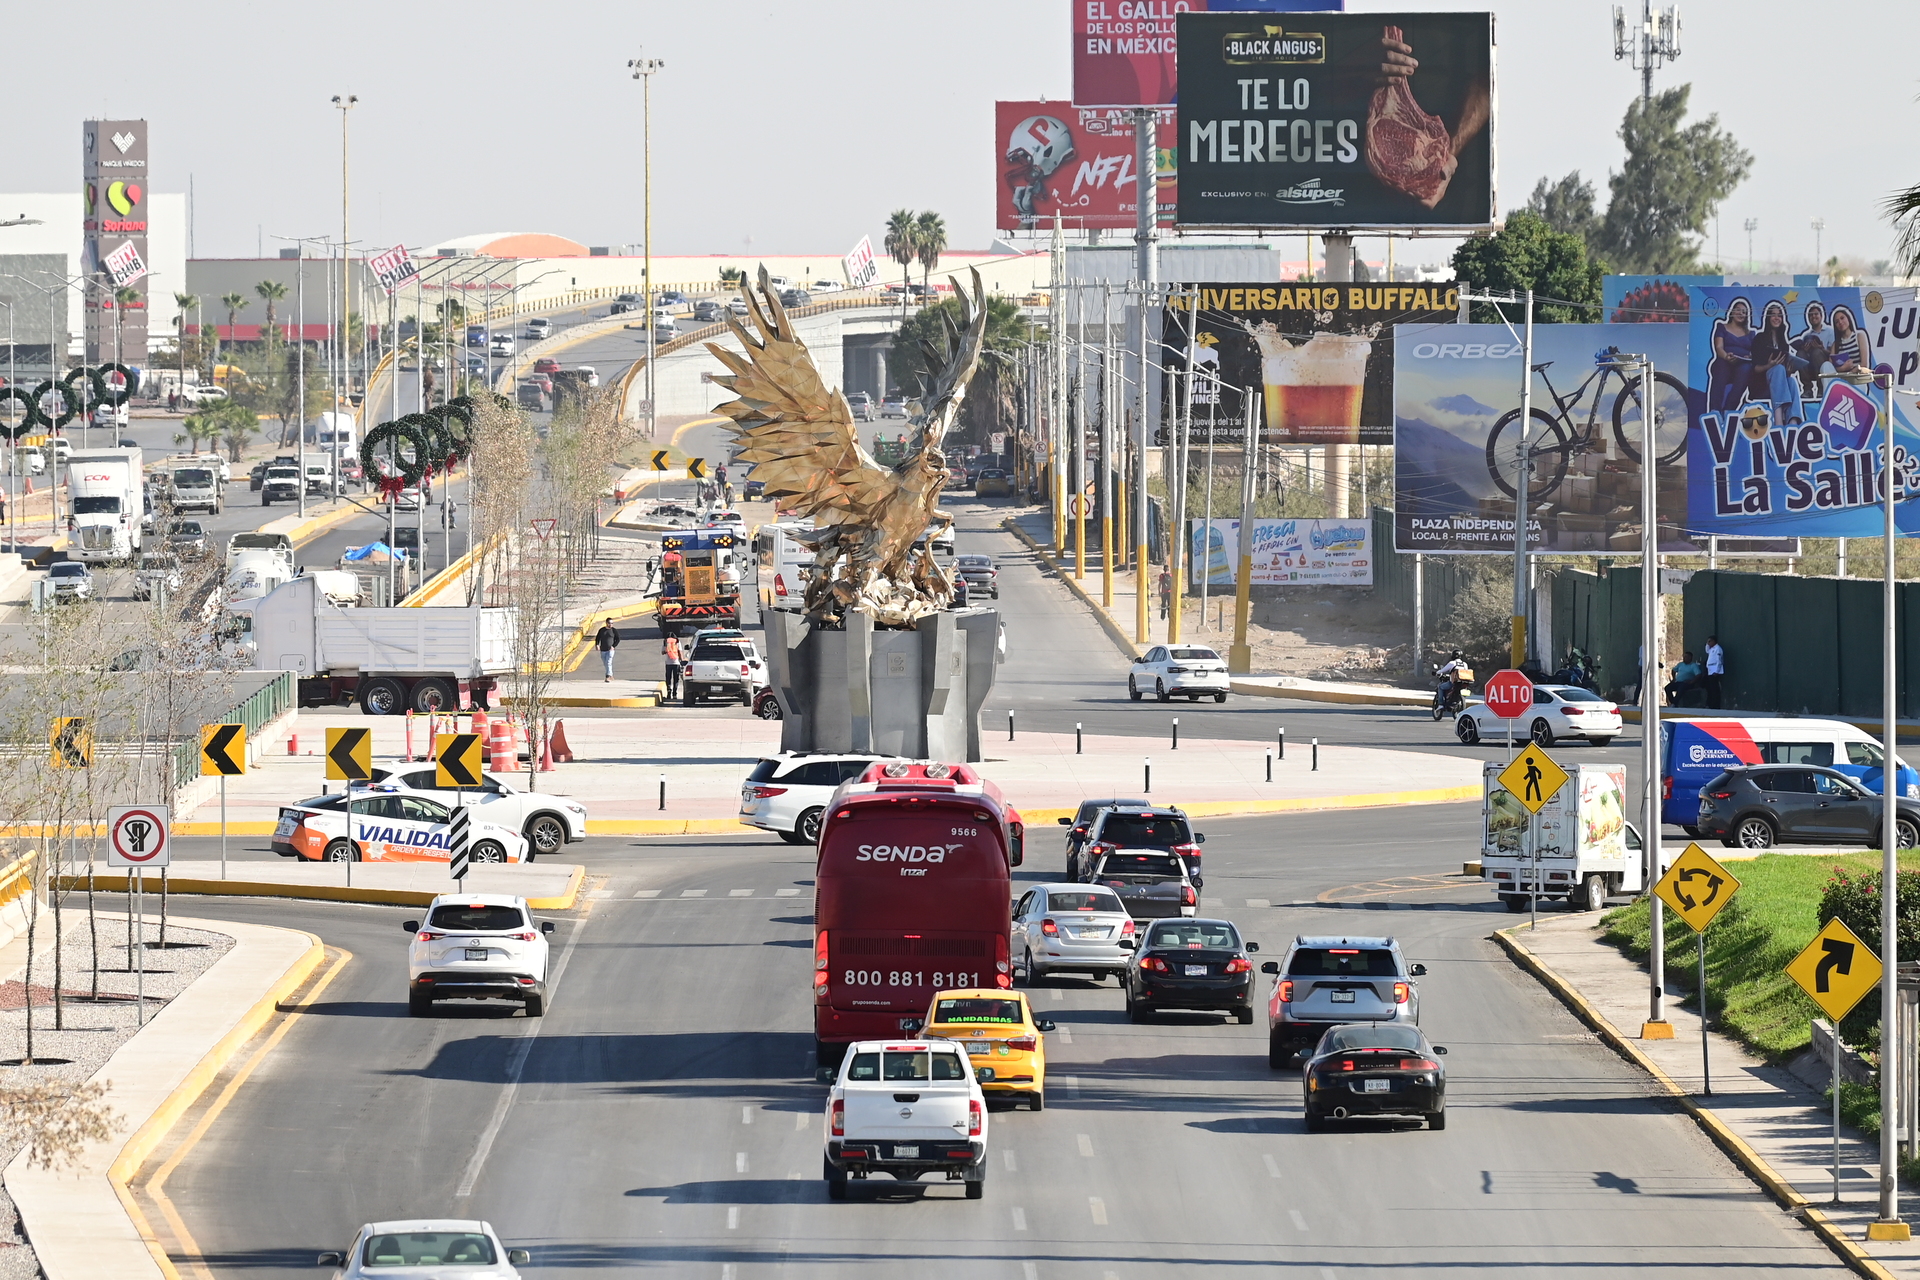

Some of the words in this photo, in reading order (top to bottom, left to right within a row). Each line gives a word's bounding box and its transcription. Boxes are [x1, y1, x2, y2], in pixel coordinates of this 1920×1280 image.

[1087, 1, 1112, 20] EL
[1087, 23, 1104, 34] DE
[1107, 22, 1134, 34] LOS
[1087, 39, 1112, 54] EN
[1231, 40, 1270, 55] BLACK
[1273, 40, 1316, 55] ANGUS
[1237, 78, 1269, 110] TE
[1278, 78, 1310, 110] LO
[1190, 119, 1358, 163] MERECES
[1071, 152, 1137, 197] NFL
[1275, 186, 1344, 200] alsuper
[103, 218, 147, 232] Soriana
[107, 243, 137, 273] CITY
[372, 244, 409, 276] CITY
[847, 239, 873, 277] CITY
[115, 258, 142, 285] CLUB
[1348, 288, 1459, 311] BUFFALO
[1412, 343, 1526, 359] ORBEA
[84, 474, 111, 482] CCN
[1715, 467, 1770, 515] La
[1786, 451, 1905, 511] Salle
[1411, 519, 1450, 530] PLAZA
[1411, 532, 1441, 540] LOCAL
[1442, 531, 1449, 540] 8
[1455, 532, 1490, 541] FRENTE
[1490, 532, 1499, 541] A
[1488, 684, 1530, 704] ALTO
[951, 827, 977, 837] 9566
[390, 844, 415, 854] ORDEN
[844, 970, 882, 986] 800
[889, 971, 923, 987] 881
[932, 971, 979, 988] 8181
[947, 1016, 1013, 1024] MANDARINAS
